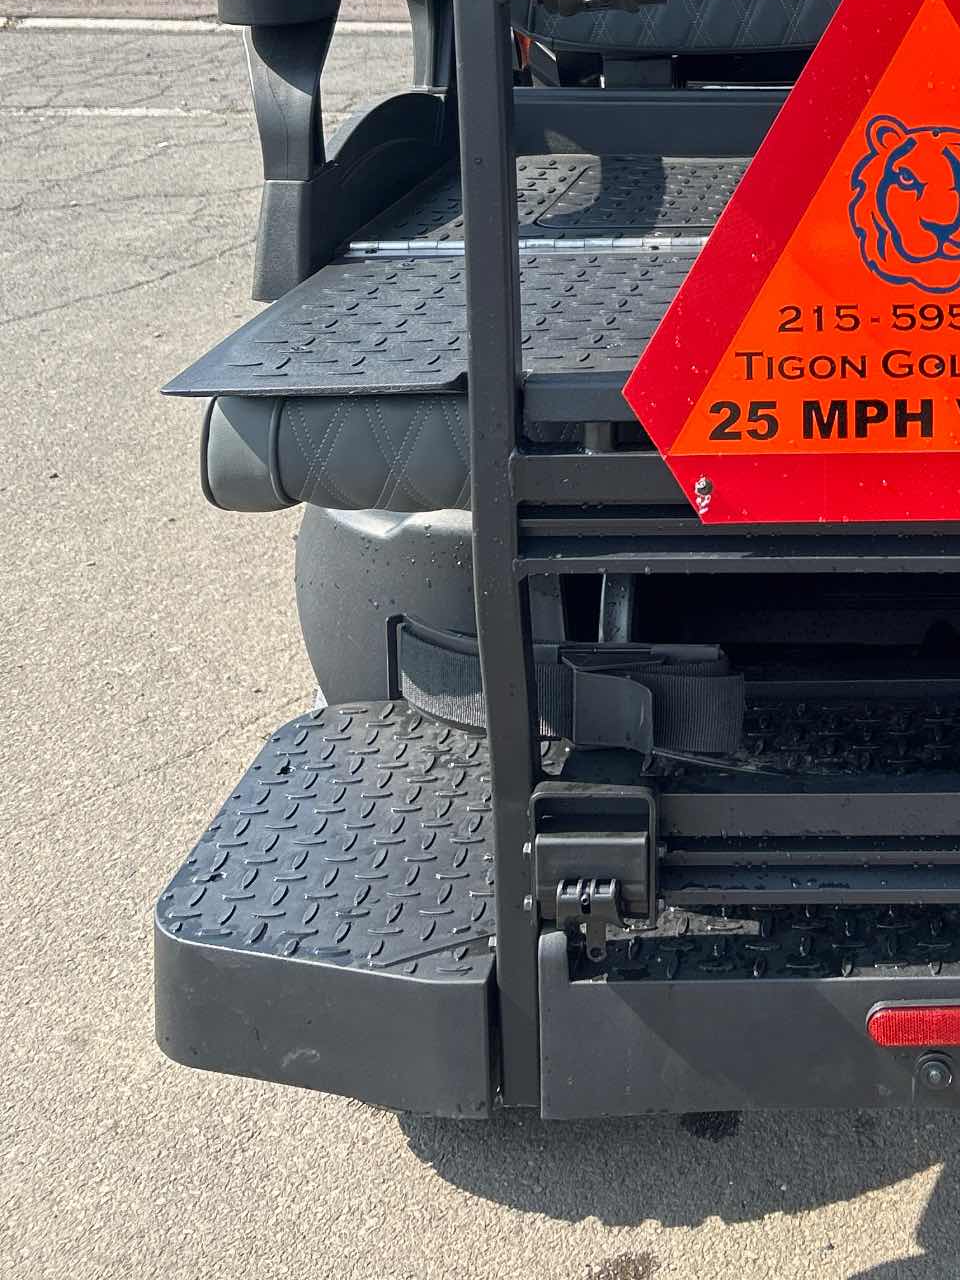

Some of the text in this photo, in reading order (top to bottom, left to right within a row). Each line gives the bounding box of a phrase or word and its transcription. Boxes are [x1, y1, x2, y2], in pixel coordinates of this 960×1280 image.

[735, 351, 867, 381] TIGON
[708, 400, 779, 441] 25
[802, 398, 934, 441] MPH
